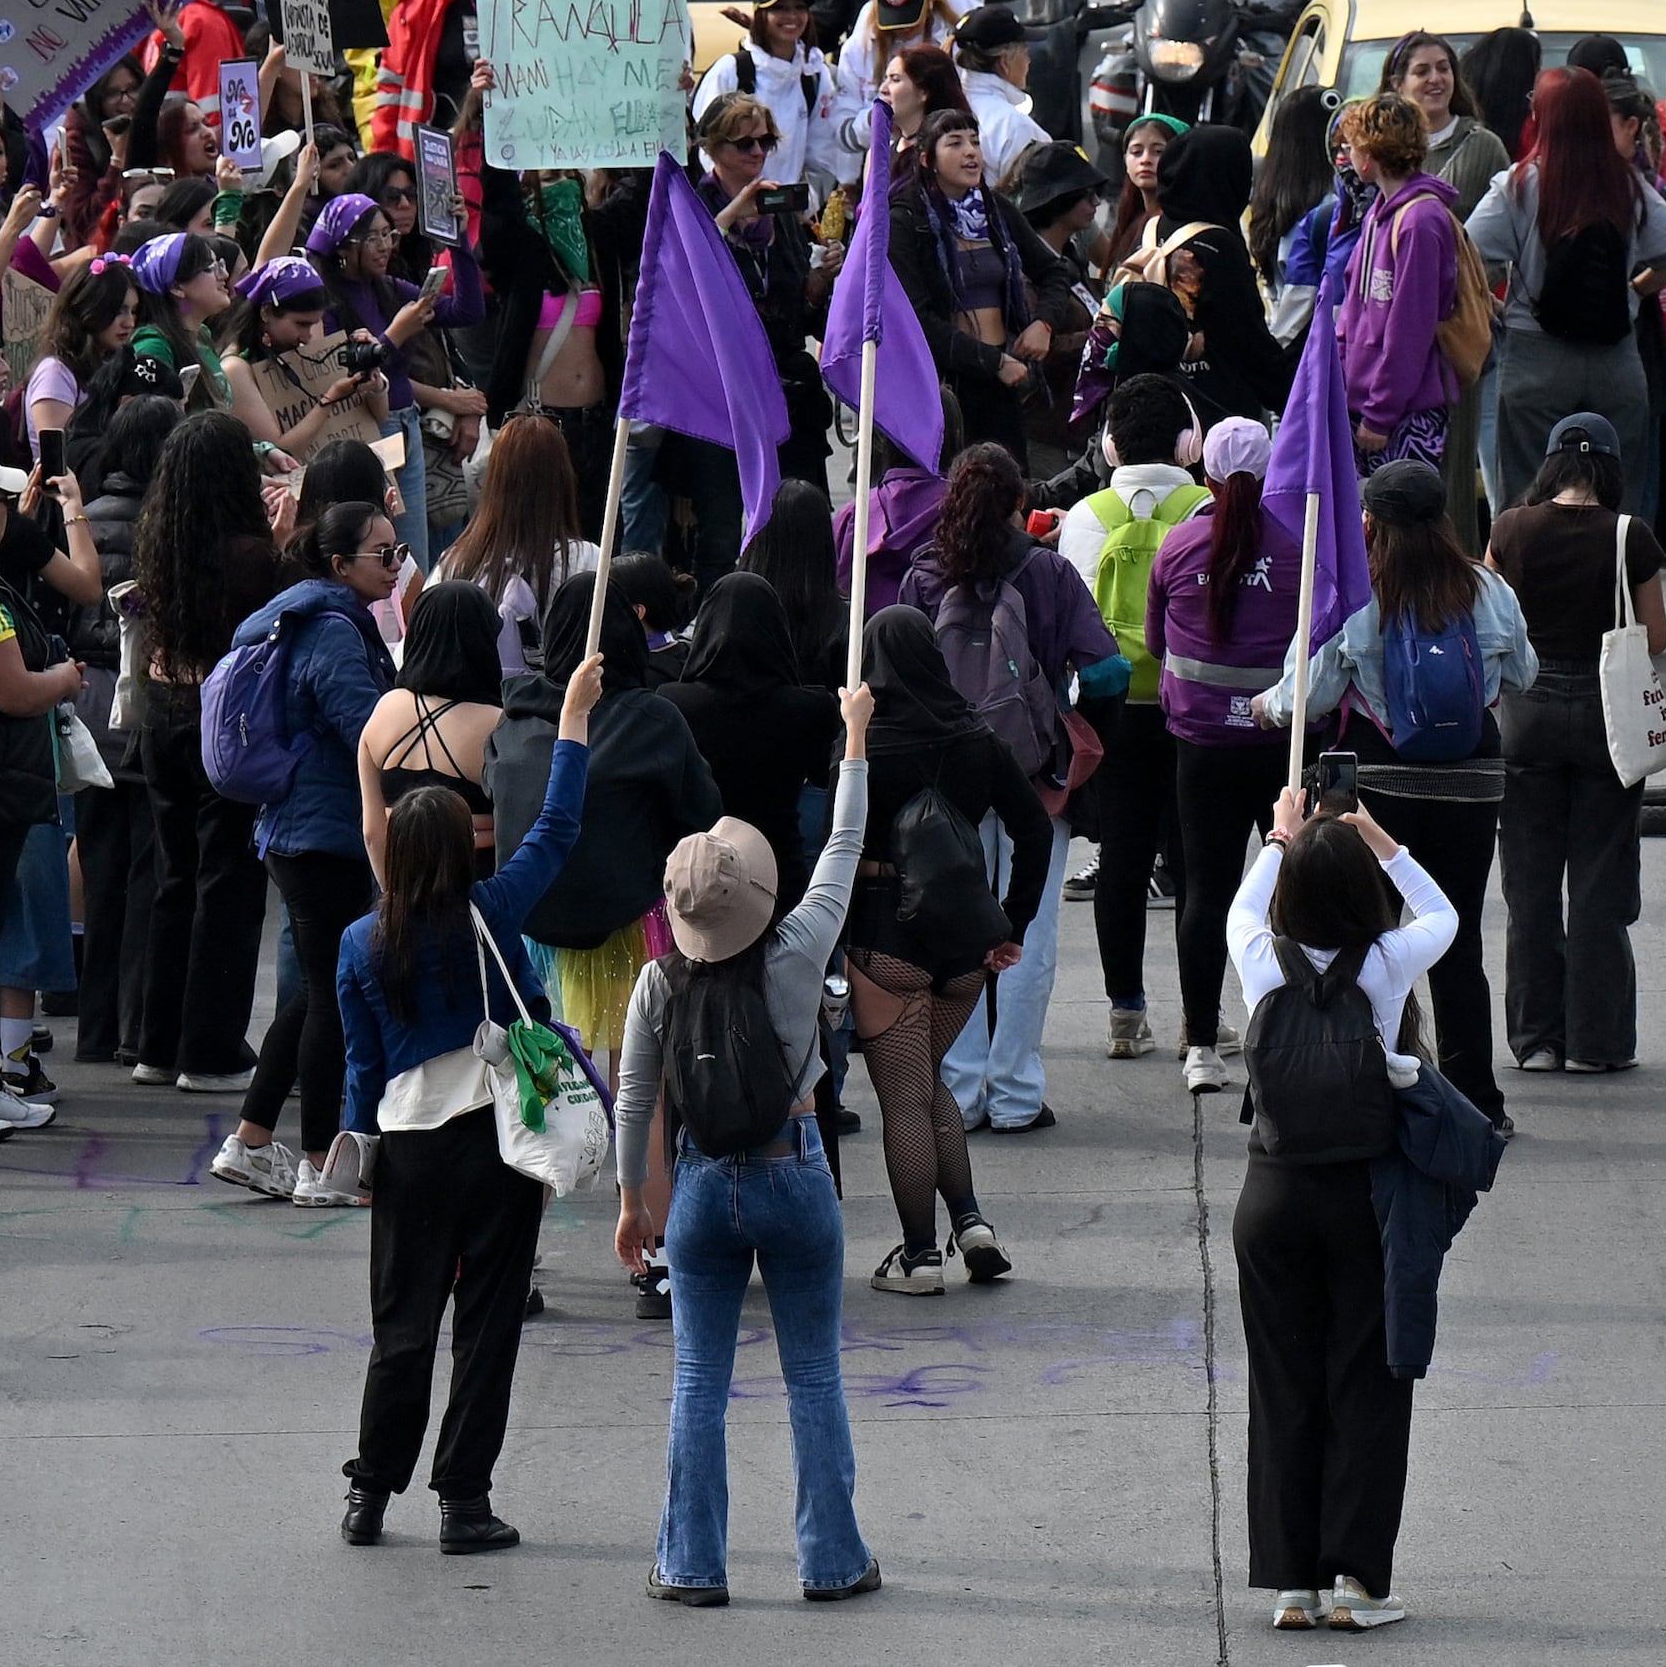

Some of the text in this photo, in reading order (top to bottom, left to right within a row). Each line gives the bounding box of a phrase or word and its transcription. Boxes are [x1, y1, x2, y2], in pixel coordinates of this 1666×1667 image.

[25, 24, 68, 64] NO
[624, 58, 673, 91] ME
[226, 78, 246, 104] No
[229, 120, 256, 152] No
